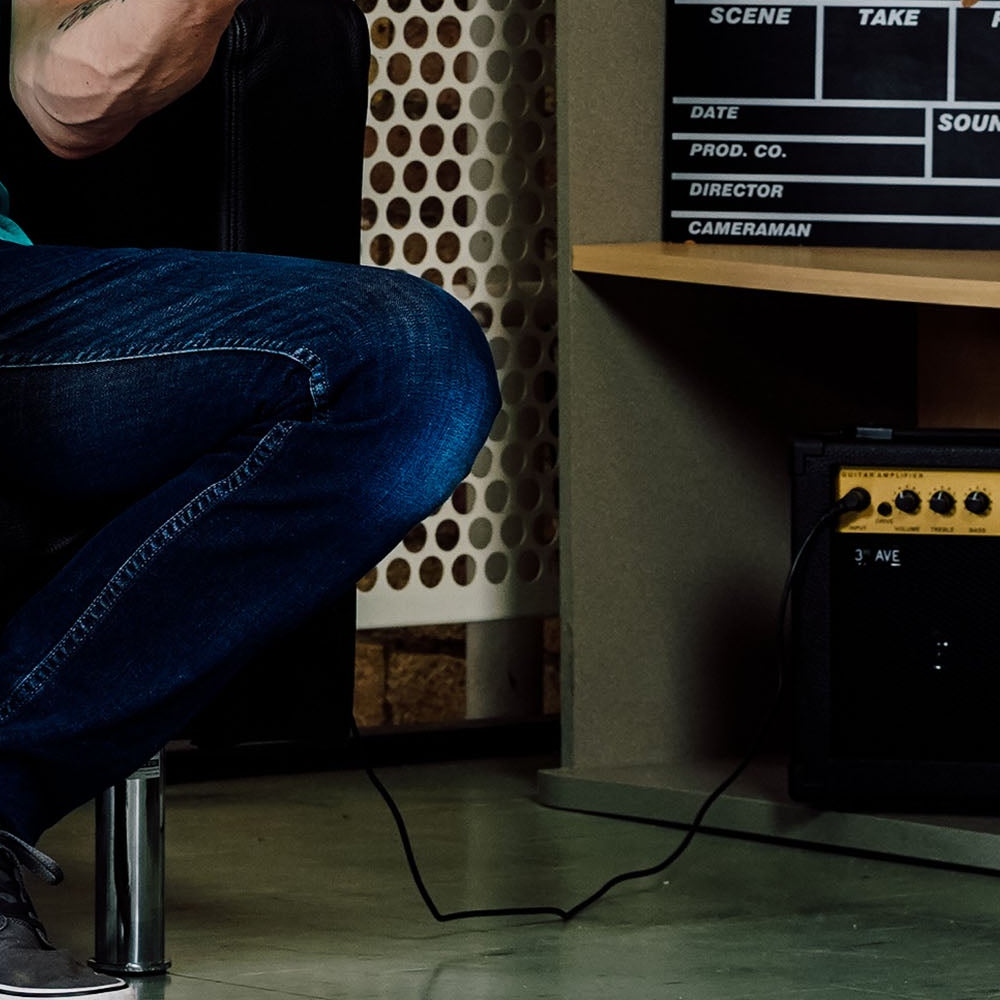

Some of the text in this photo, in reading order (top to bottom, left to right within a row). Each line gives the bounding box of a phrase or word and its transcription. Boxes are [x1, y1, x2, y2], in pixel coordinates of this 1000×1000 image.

[709, 7, 792, 25] SCENE
[858, 8, 921, 27] TAKE
[690, 106, 740, 120] DATE
[689, 143, 787, 159] PROD. CO.
[689, 183, 784, 199] DIRECTOR
[688, 221, 812, 238] CAMERAMAN
[875, 549, 900, 563] AVE
